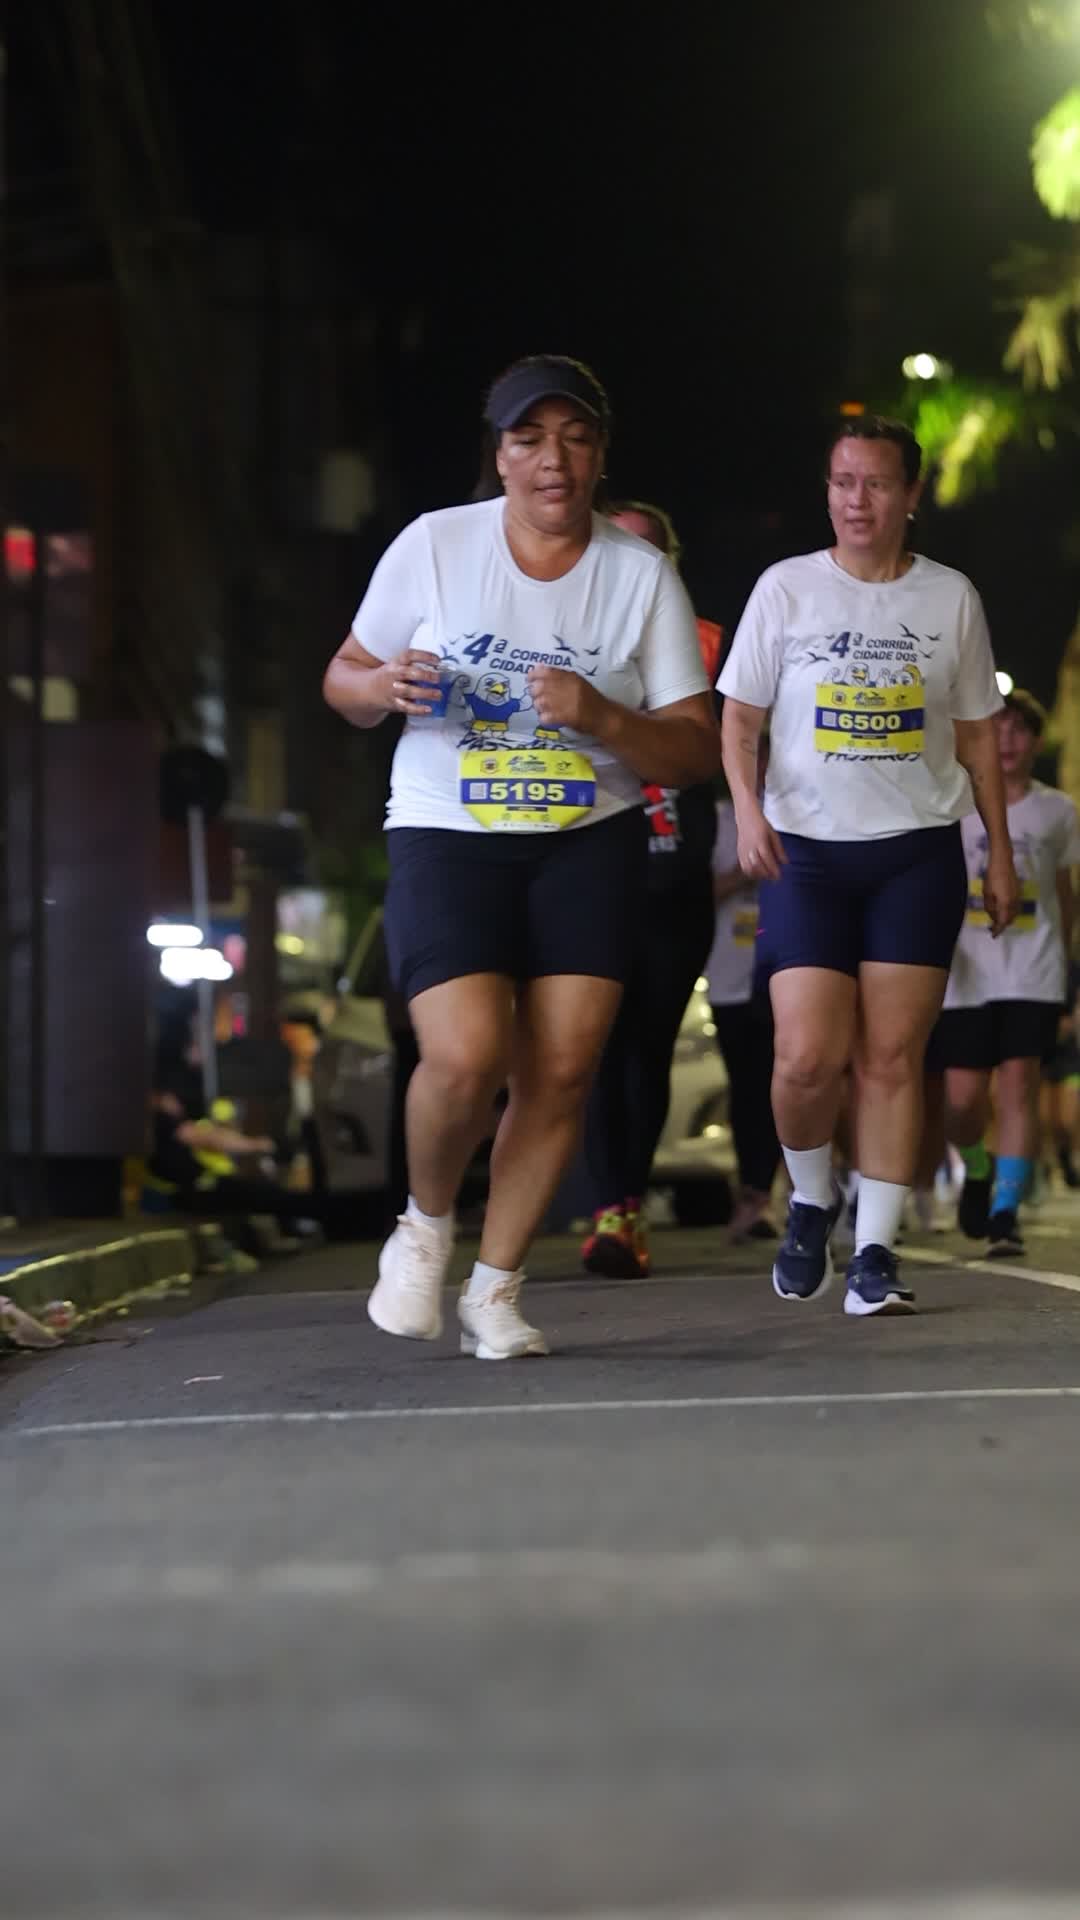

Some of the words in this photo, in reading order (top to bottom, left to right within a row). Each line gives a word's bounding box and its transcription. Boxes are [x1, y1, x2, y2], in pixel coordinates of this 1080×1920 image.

[866, 639, 914, 651] CORRIDA
[510, 648, 573, 667] CORRIDA
[852, 650, 893, 661] CIDADE
[895, 651, 918, 663] DOS
[489, 657, 535, 675] CIDAD
[838, 713, 901, 731] 6500
[489, 782, 565, 802] 5195
